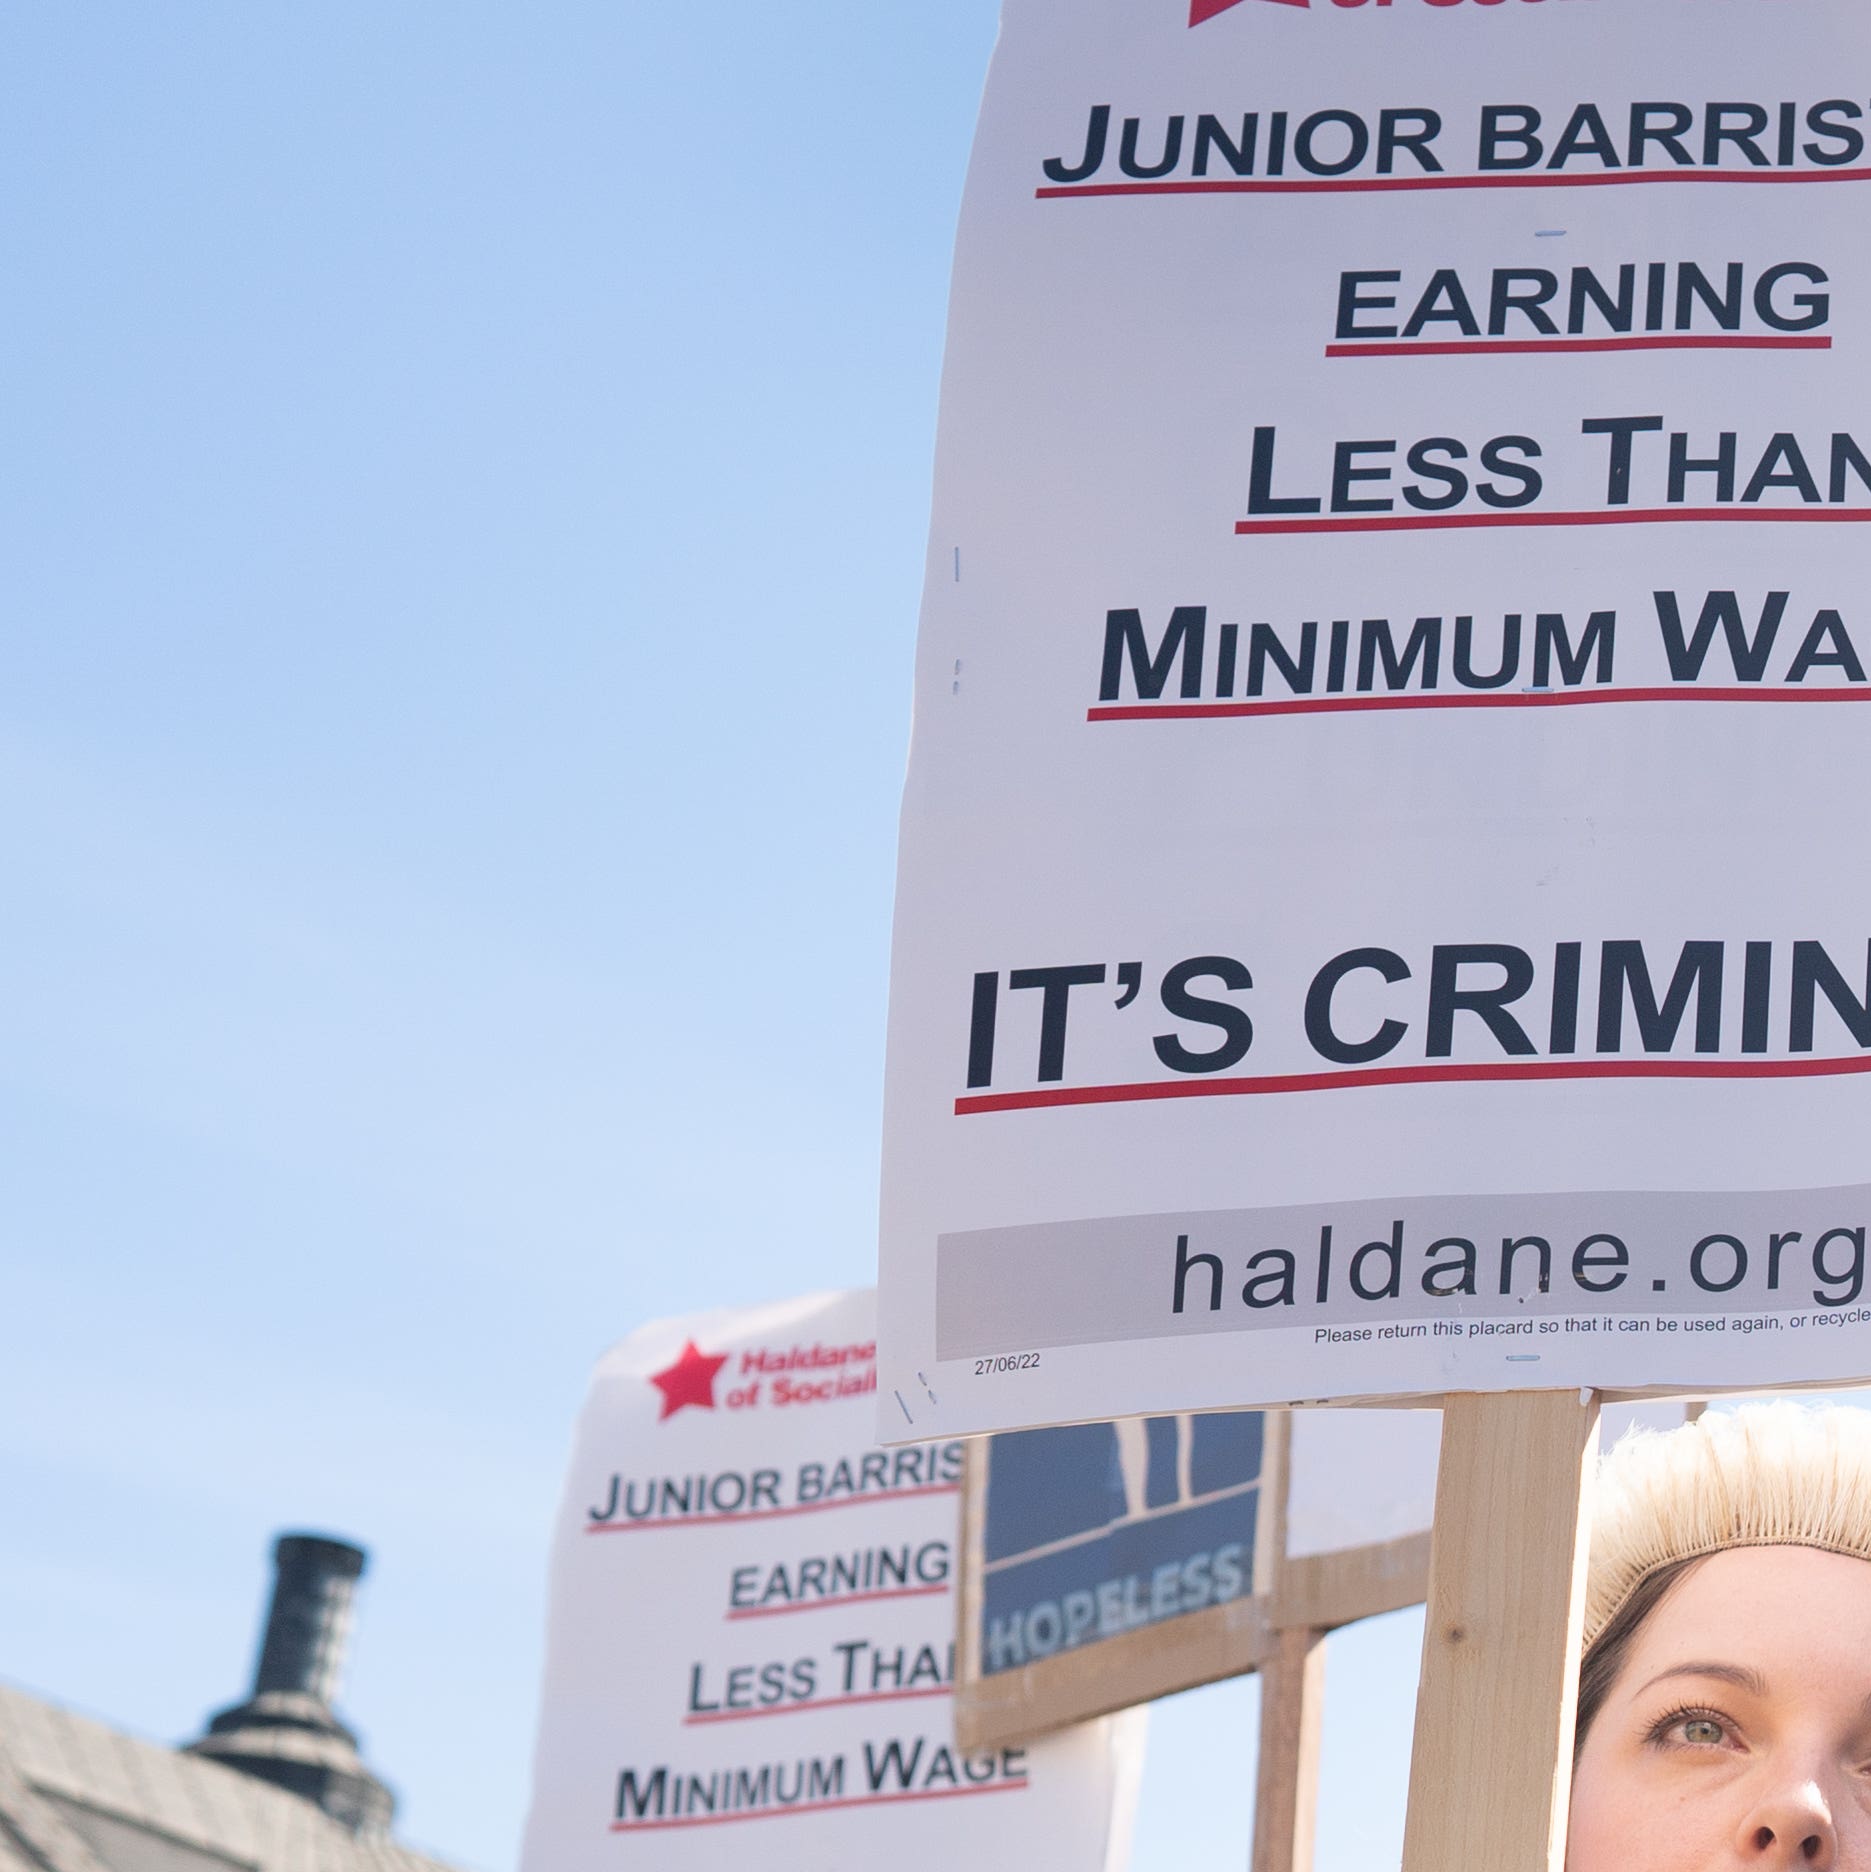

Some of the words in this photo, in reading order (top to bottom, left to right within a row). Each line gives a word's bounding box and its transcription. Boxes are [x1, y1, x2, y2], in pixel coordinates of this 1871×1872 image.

[1043, 105, 1444, 182] JUNIOR
[1336, 262, 1829, 338] EARNING
[1248, 427, 1542, 514] LESS
[1099, 606, 1616, 701] MINIMUM
[967, 956, 1253, 1088] IT’S
[1173, 1220, 1870, 1320] haldane.org
[974, 1352, 1041, 1376] 27/06/22
[1315, 1328, 1373, 1343] Please
[1378, 1324, 1427, 1339] return
[1432, 1321, 1463, 1336] this
[1469, 1320, 1533, 1338] placard
[1539, 1322, 1559, 1334] so
[1564, 1318, 1598, 1332] that
[1603, 1317, 1613, 1331] it
[1618, 1320, 1650, 1332] can
[1656, 1317, 1678, 1332] be
[1683, 1317, 1725, 1332] used
[1732, 1317, 1784, 1334] again,
[1789, 1314, 1807, 1329] or
[1812, 1308, 1871, 1328] recycle
[727, 1381, 758, 1410] of
[590, 1471, 781, 1522] JUNIOR
[797, 1442, 964, 1502] BARRIS
[731, 1542, 949, 1608] EARNING
[989, 1542, 1244, 1670] HOPELESS
[690, 1660, 815, 1712] LESS
[834, 1639, 957, 1690] THA
[616, 1757, 844, 1819] MINIMUM
[862, 1737, 1028, 1791] WAGE
